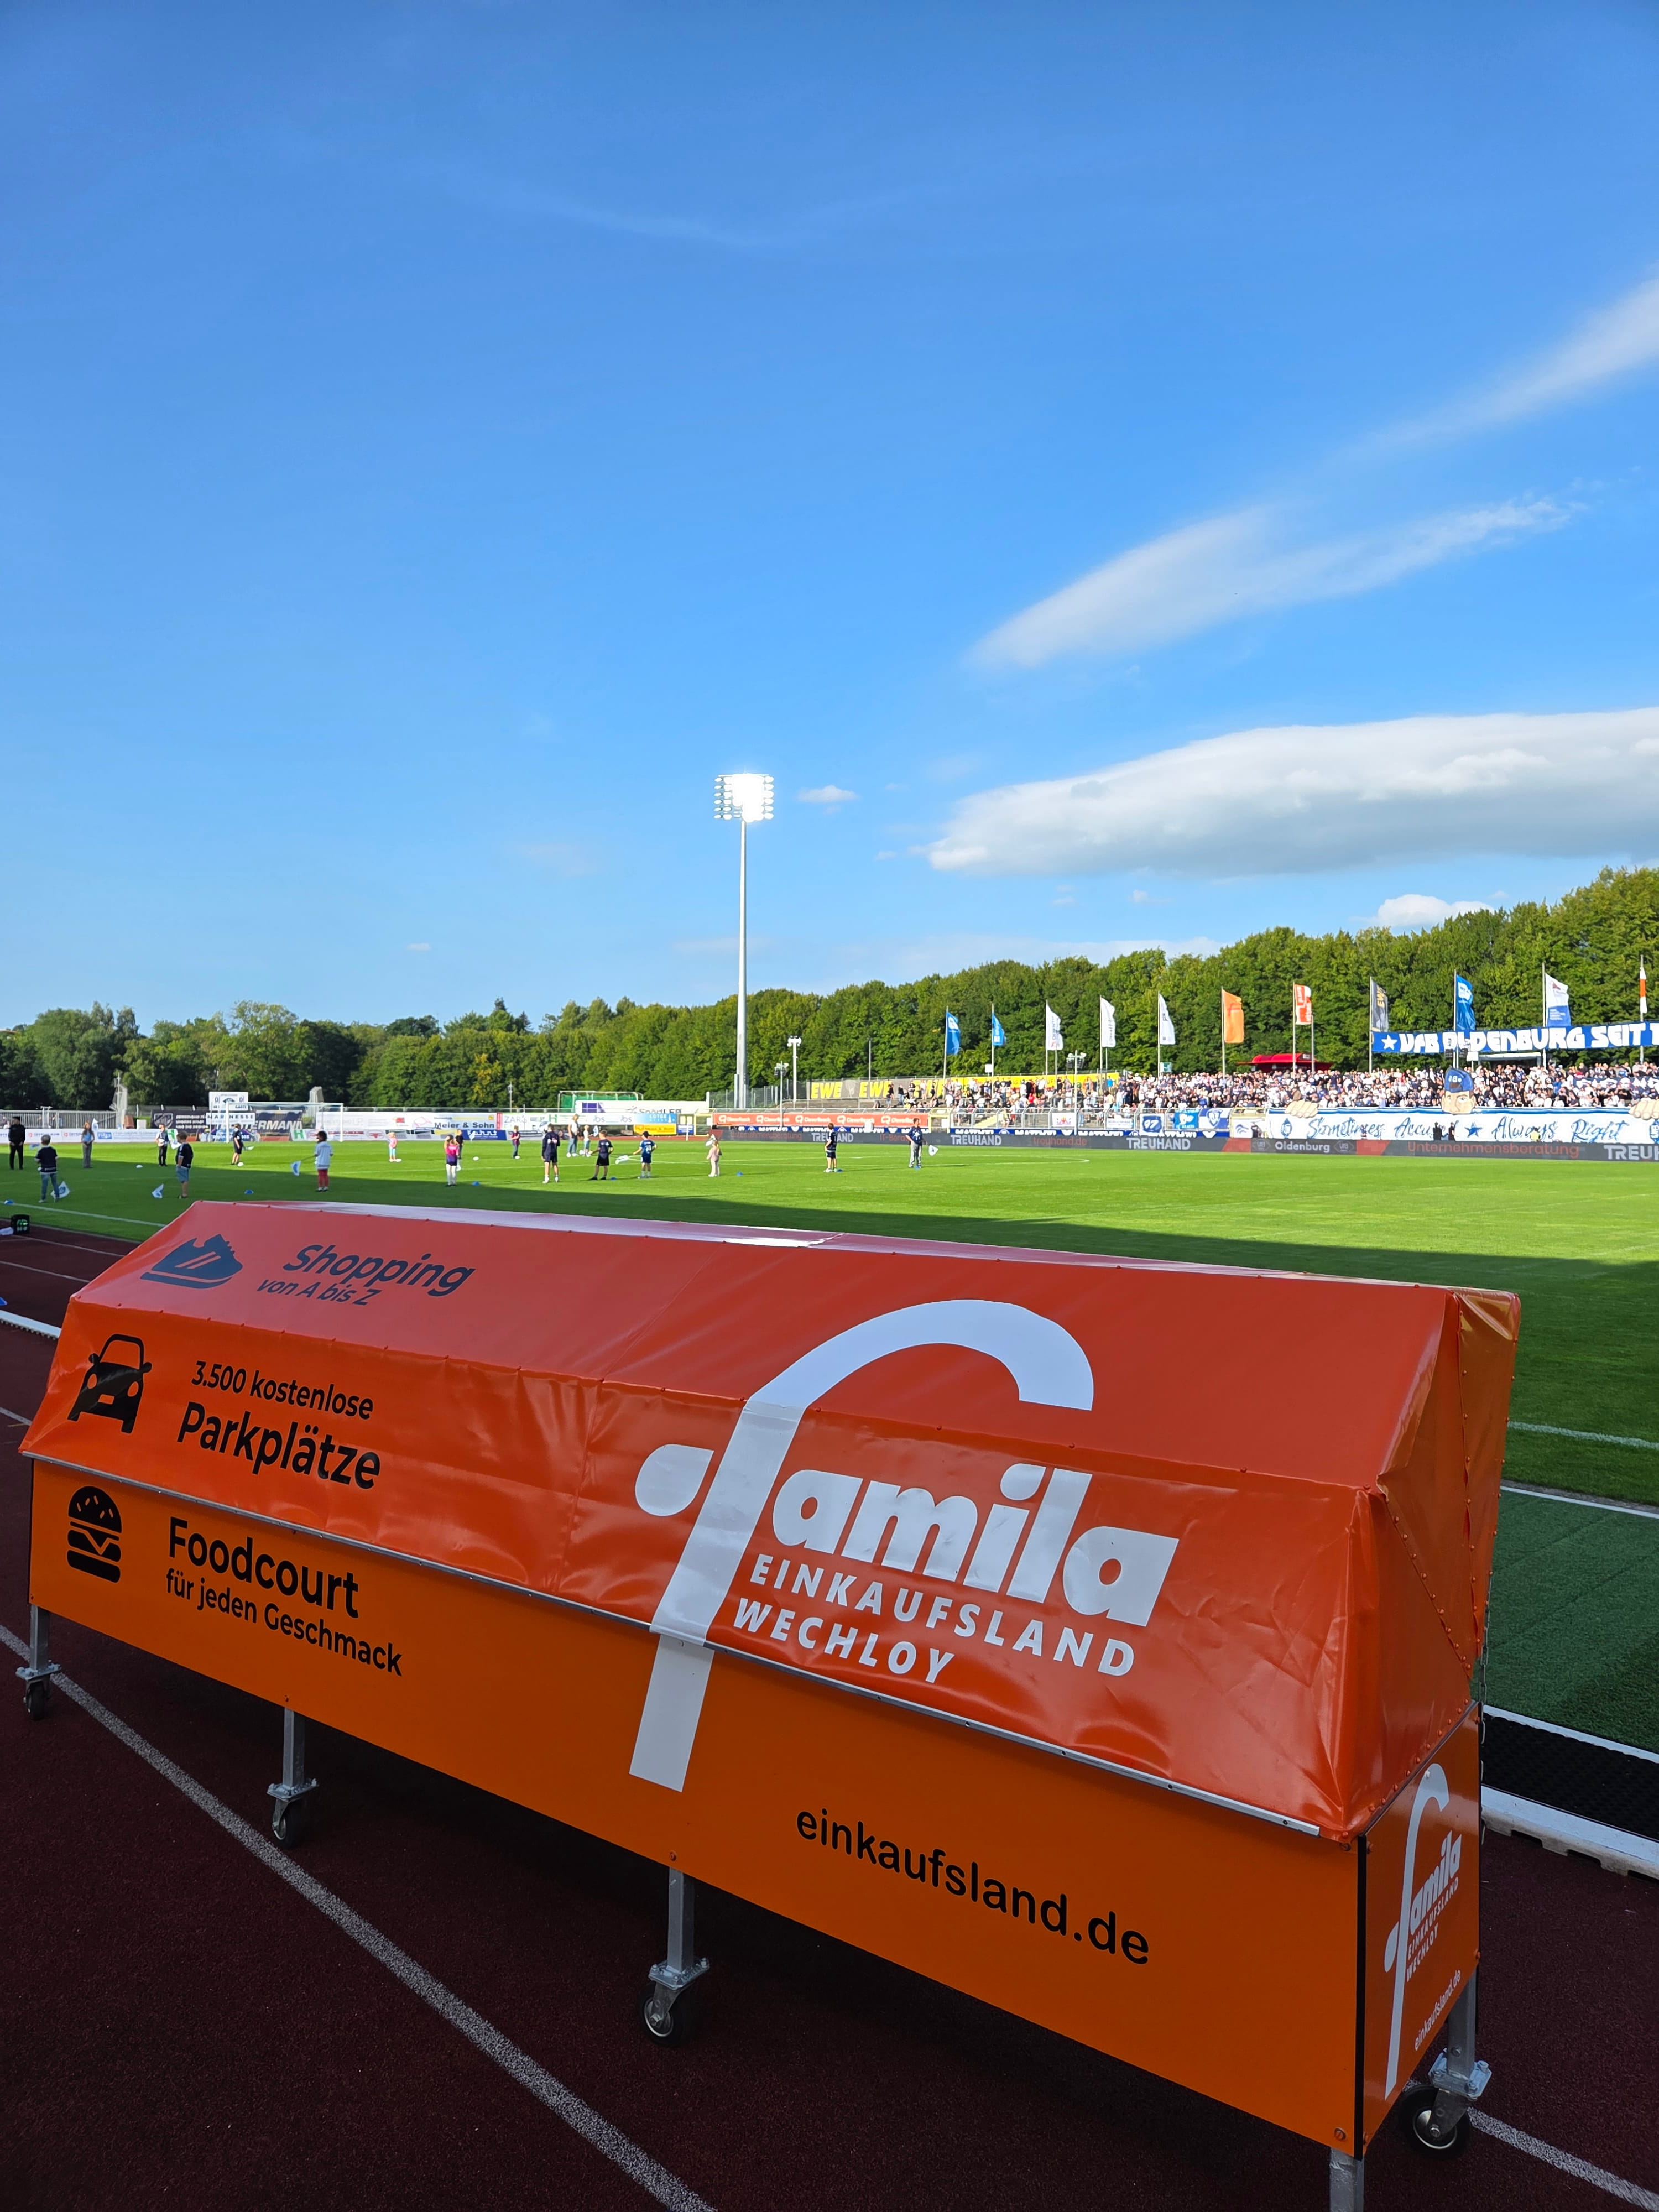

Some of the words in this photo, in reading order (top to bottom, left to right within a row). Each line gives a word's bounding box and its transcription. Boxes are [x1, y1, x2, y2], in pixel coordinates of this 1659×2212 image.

[1591, 1022, 1646, 1048] SEIT
[811, 1081, 842, 1099] EWE
[950, 1135, 1001, 1146] TREUHAND
[1126, 1138, 1191, 1150] TREUHAND
[1275, 1142, 1330, 1153] Oldenburg
[1408, 1142, 1579, 1158] Unternehmensberatung
[257, 1278, 297, 1296] von
[297, 1282, 316, 1297] A
[319, 1283, 352, 1303] bis
[352, 1288, 382, 1306] Z
[283, 1244, 476, 1297] Shopping
[191, 1361, 246, 1394] 3.500
[250, 1370, 374, 1420] kostenlose
[177, 1401, 380, 1489] Parkplätze
[169, 1516, 359, 1618] Foodcourt
[629, 1299, 1179, 1792] famila
[166, 1568, 194, 1601] für
[197, 1578, 256, 1624] jeden
[264, 1603, 403, 1677] Geschmack
[733, 1598, 955, 1683] WECHLOY
[750, 1554, 1134, 1677] EINKAUFSLAND
[796, 1808, 1149, 1965] einkaufsland.de
[1408, 1877, 1459, 1960] EINKAUFSLAND
[1406, 1922, 1439, 1983] WECHLOY
[1414, 1969, 1461, 2052] einkaufsland.de
